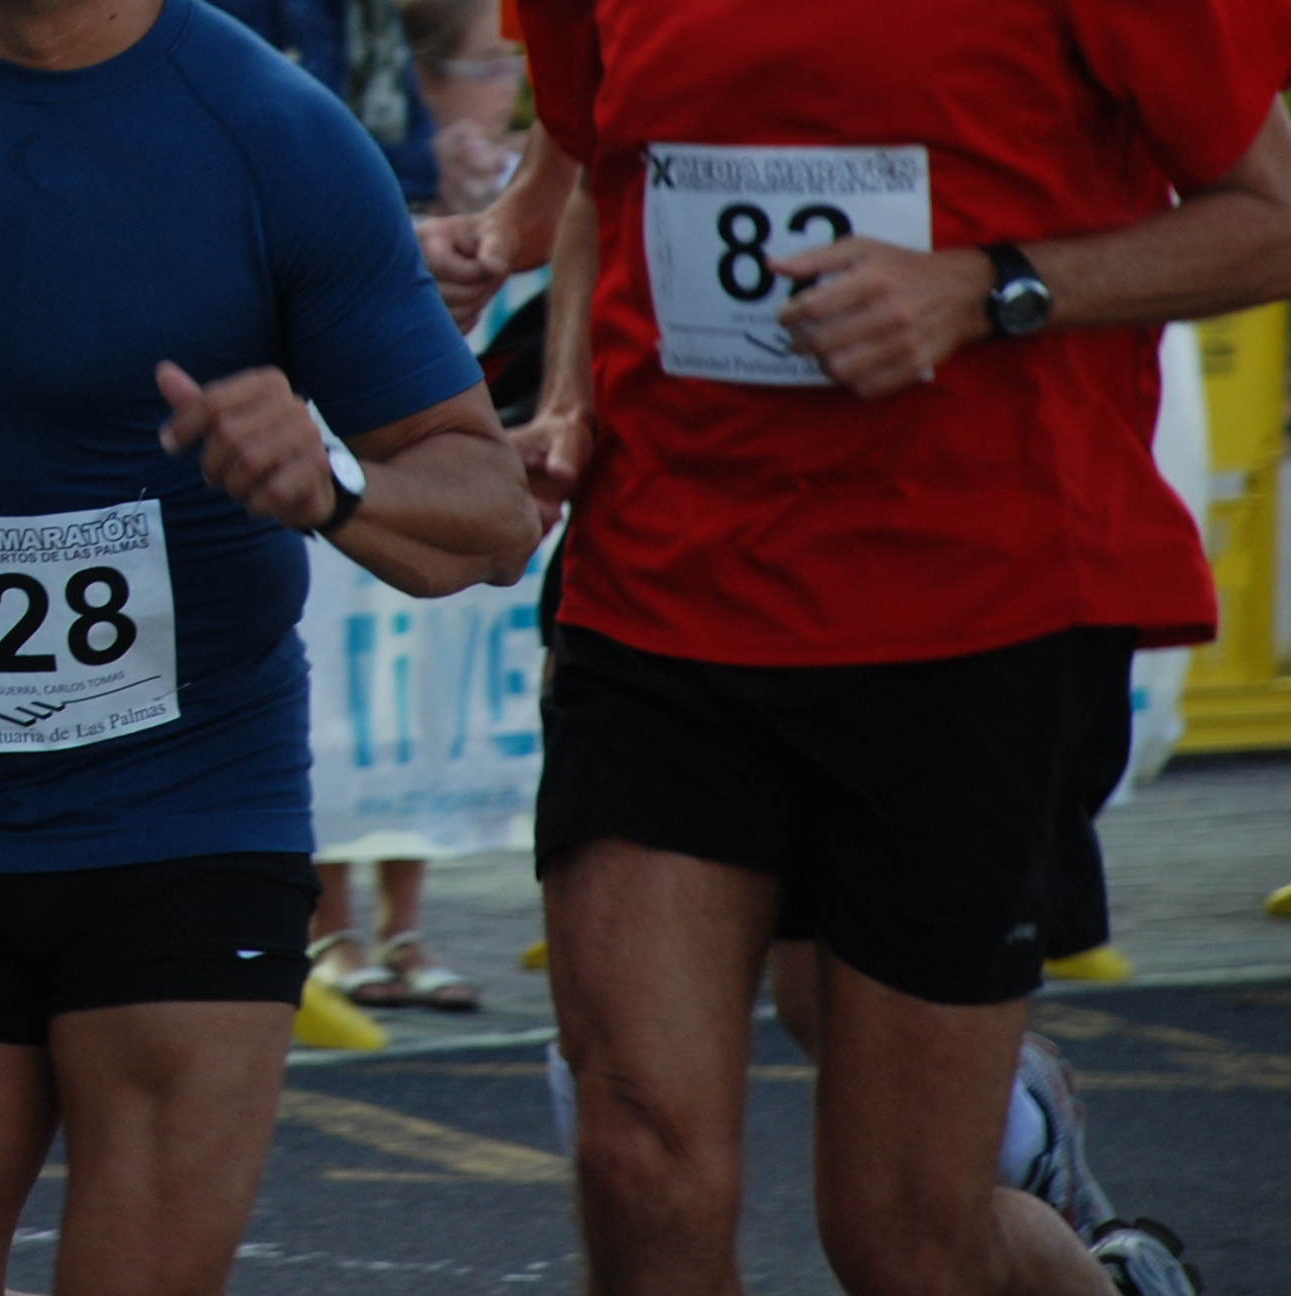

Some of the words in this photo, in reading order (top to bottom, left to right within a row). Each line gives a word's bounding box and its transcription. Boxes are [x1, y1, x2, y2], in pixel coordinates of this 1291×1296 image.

[42, 549, 62, 563] DE
[64, 546, 92, 561] LAS
[95, 537, 151, 559] PALMAS
[44, 682, 87, 696] CARLOS
[49, 725, 70, 742] de
[75, 723, 107, 739] Las
[109, 702, 168, 728] Palmas
